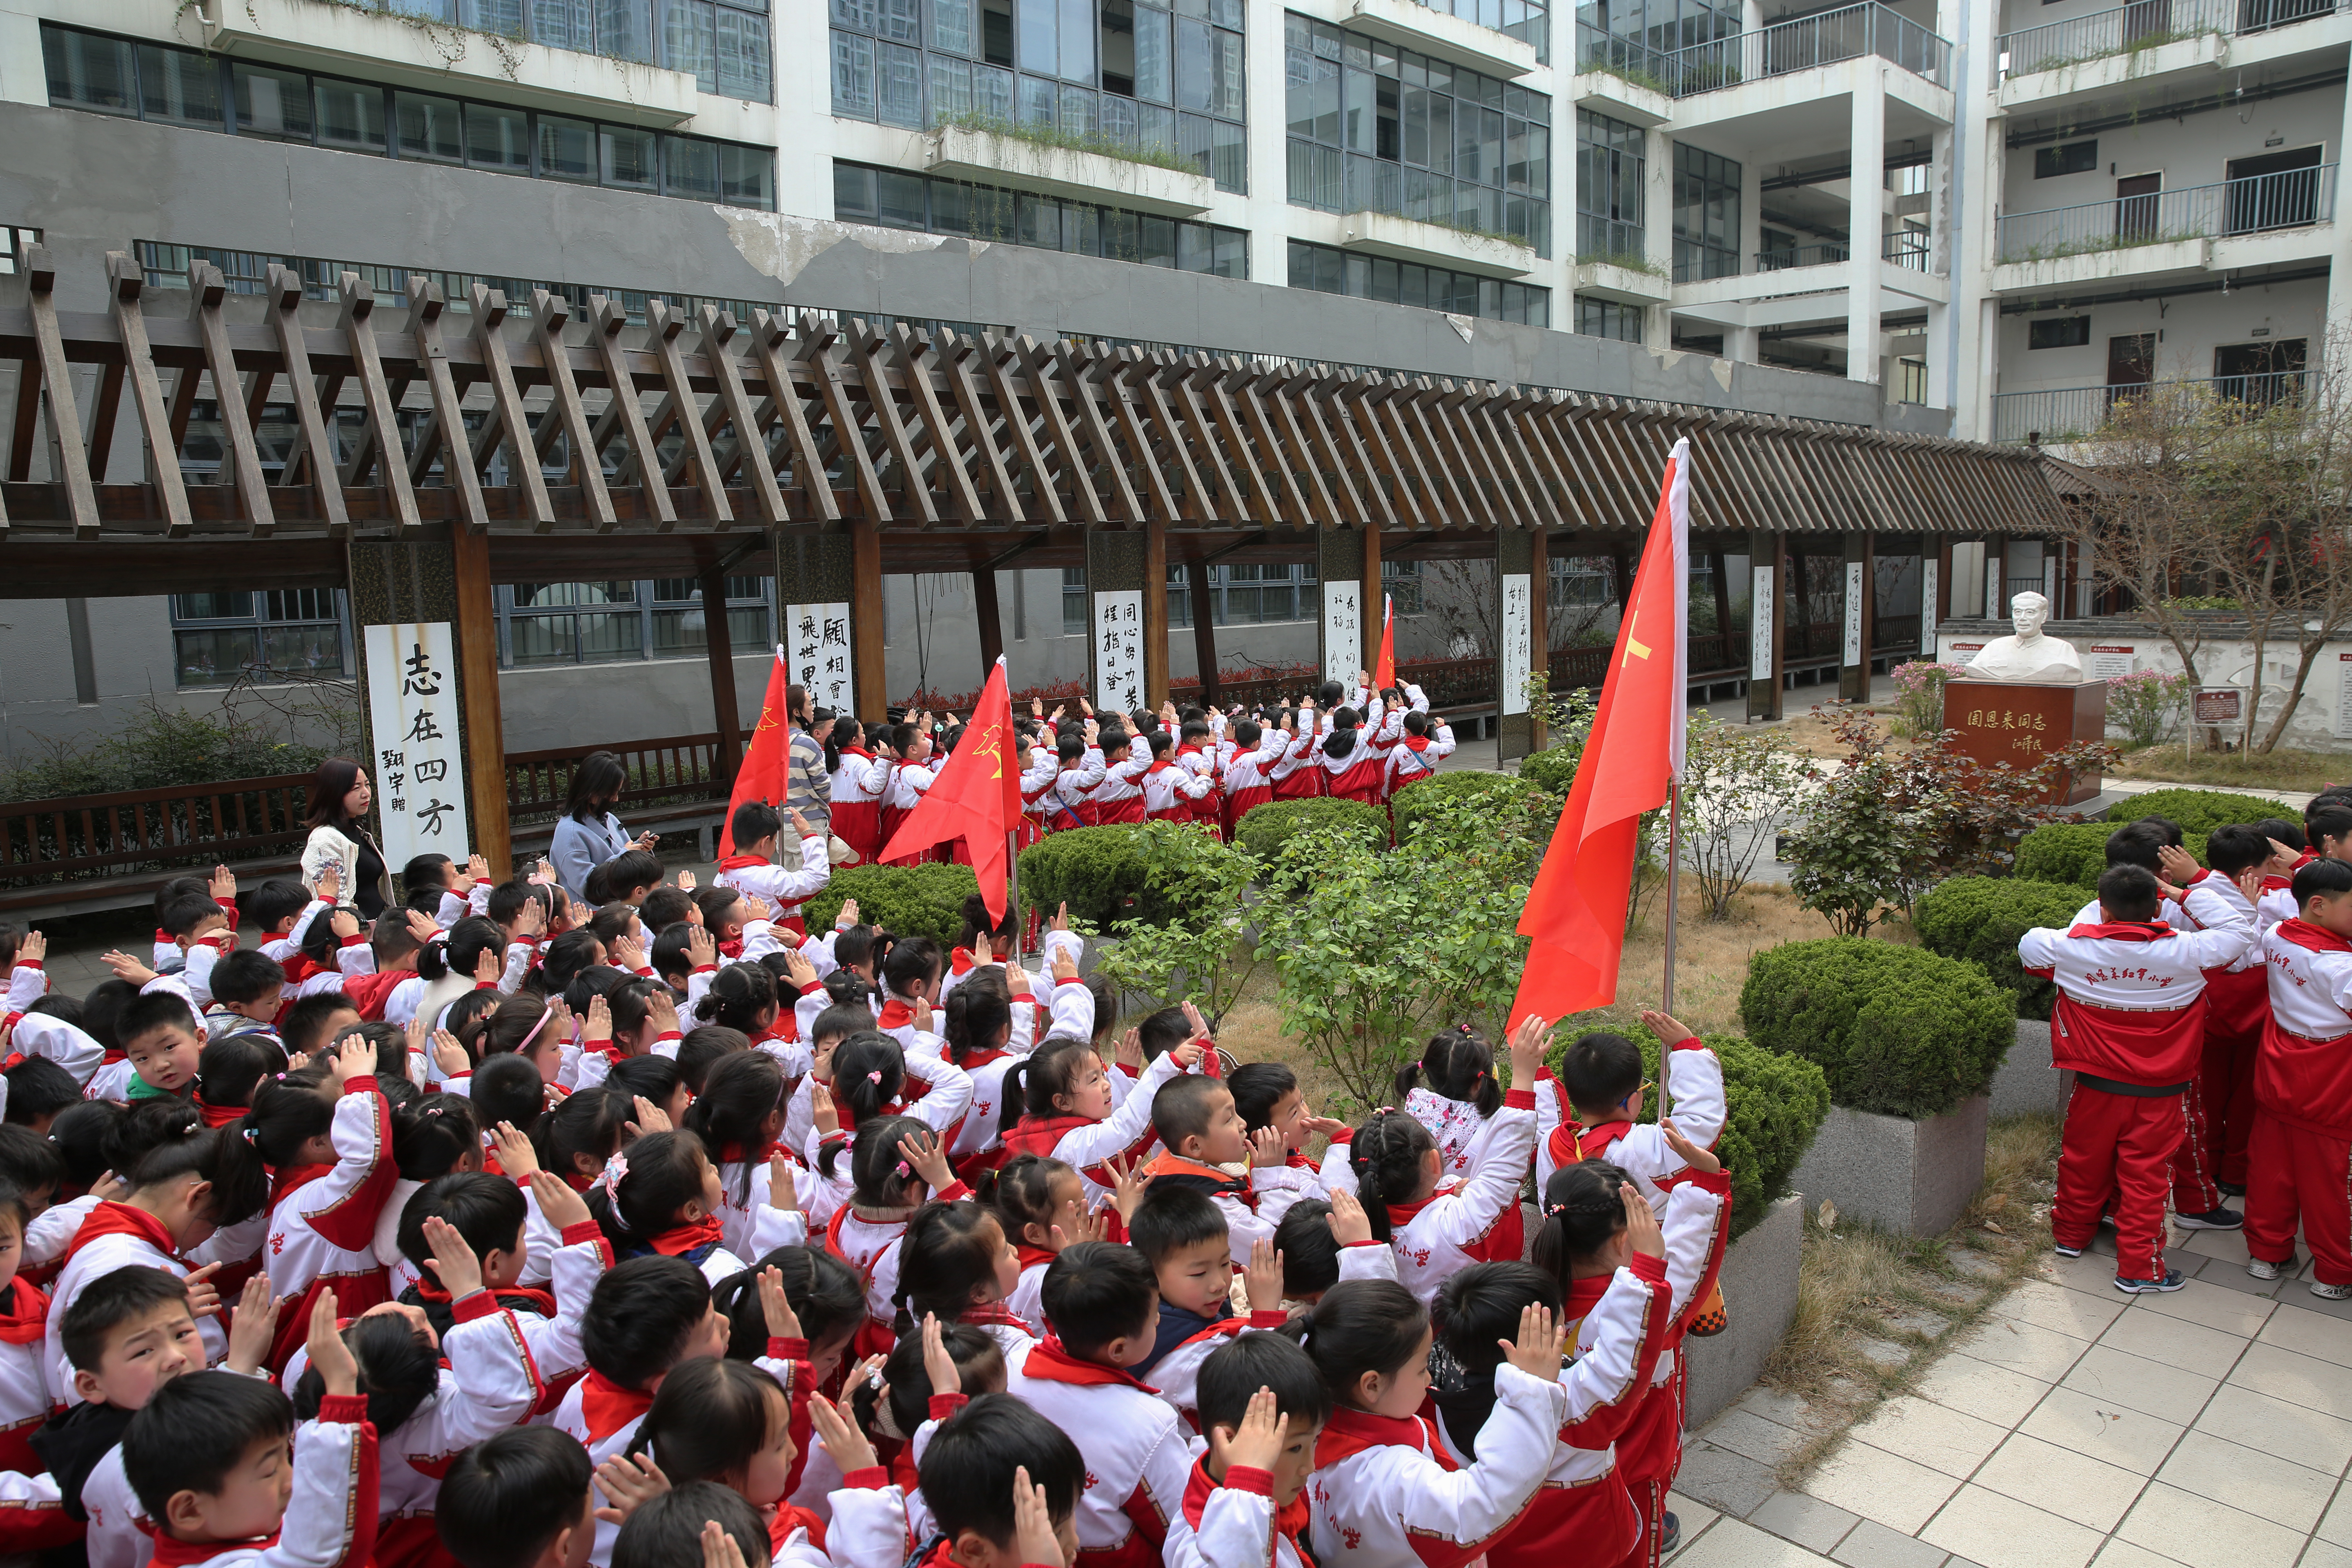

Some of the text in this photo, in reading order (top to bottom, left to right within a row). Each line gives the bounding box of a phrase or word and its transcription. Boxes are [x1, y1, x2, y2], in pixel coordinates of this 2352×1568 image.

[401, 643, 454, 836] 志在四方
[1967, 710, 2047, 731] 周恩来同志
